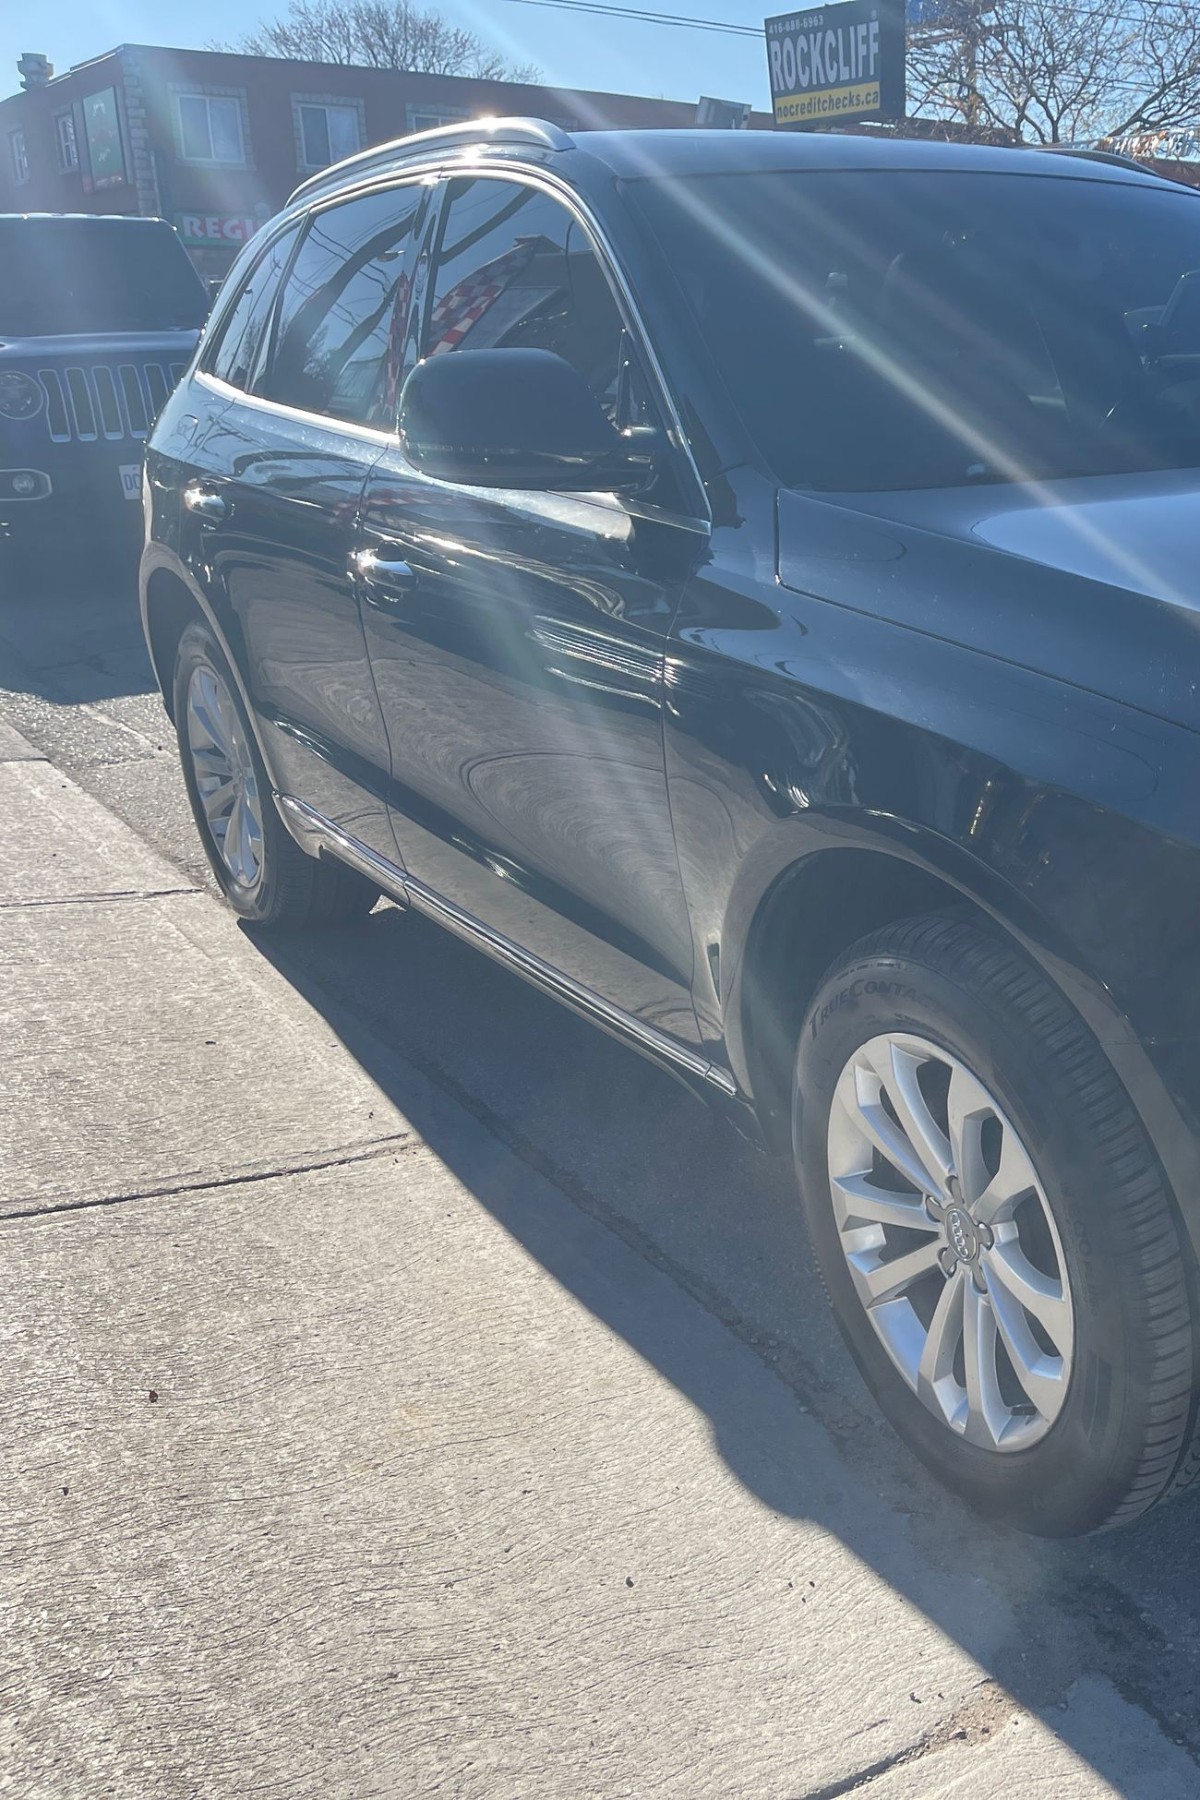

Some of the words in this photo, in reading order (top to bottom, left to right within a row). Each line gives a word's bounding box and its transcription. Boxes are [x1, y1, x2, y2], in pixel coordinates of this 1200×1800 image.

[770, 21, 879, 92] ROCKCLIFF
[776, 90, 879, 118] nocreditchecks.ca
[182, 215, 263, 240] REGI
